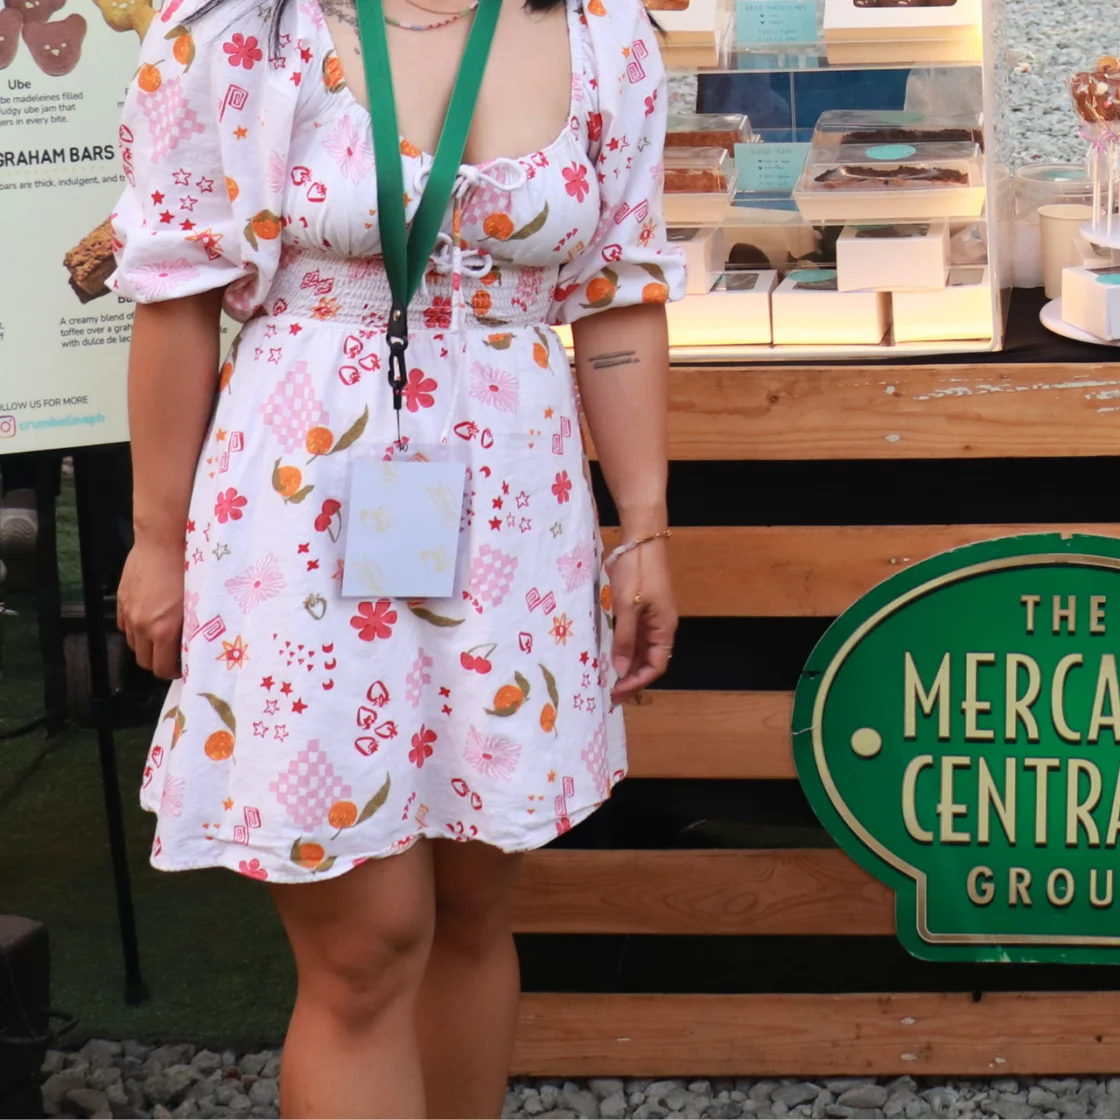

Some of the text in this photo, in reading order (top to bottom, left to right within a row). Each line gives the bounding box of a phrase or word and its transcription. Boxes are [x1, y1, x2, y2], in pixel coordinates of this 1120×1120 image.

[8, 79, 32, 90] Ube
[13, 93, 60, 104] madeleines
[62, 92, 84, 100] filled
[24, 105, 39, 114] ube
[41, 105, 57, 115] jam
[58, 103, 76, 112] that
[16, 117, 23, 125] in
[26, 117, 49, 126] every
[69, 145, 115, 162] BARS
[19, 181, 32, 189] are
[34, 179, 57, 189] thick,
[58, 176, 100, 187] indulgent,
[102, 174, 118, 184] and
[60, 317, 67, 325] A
[68, 315, 99, 326] creamy
[101, 312, 124, 322] blend
[60, 327, 85, 337] toffee
[86, 326, 105, 335] over
[61, 339, 80, 348] with
[82, 337, 105, 347] dulce
[106, 335, 117, 344] de
[29, 399, 42, 409] US
[43, 398, 61, 408] FOR
[63, 395, 89, 405] MORE
[1020, 594, 1107, 634] THE
